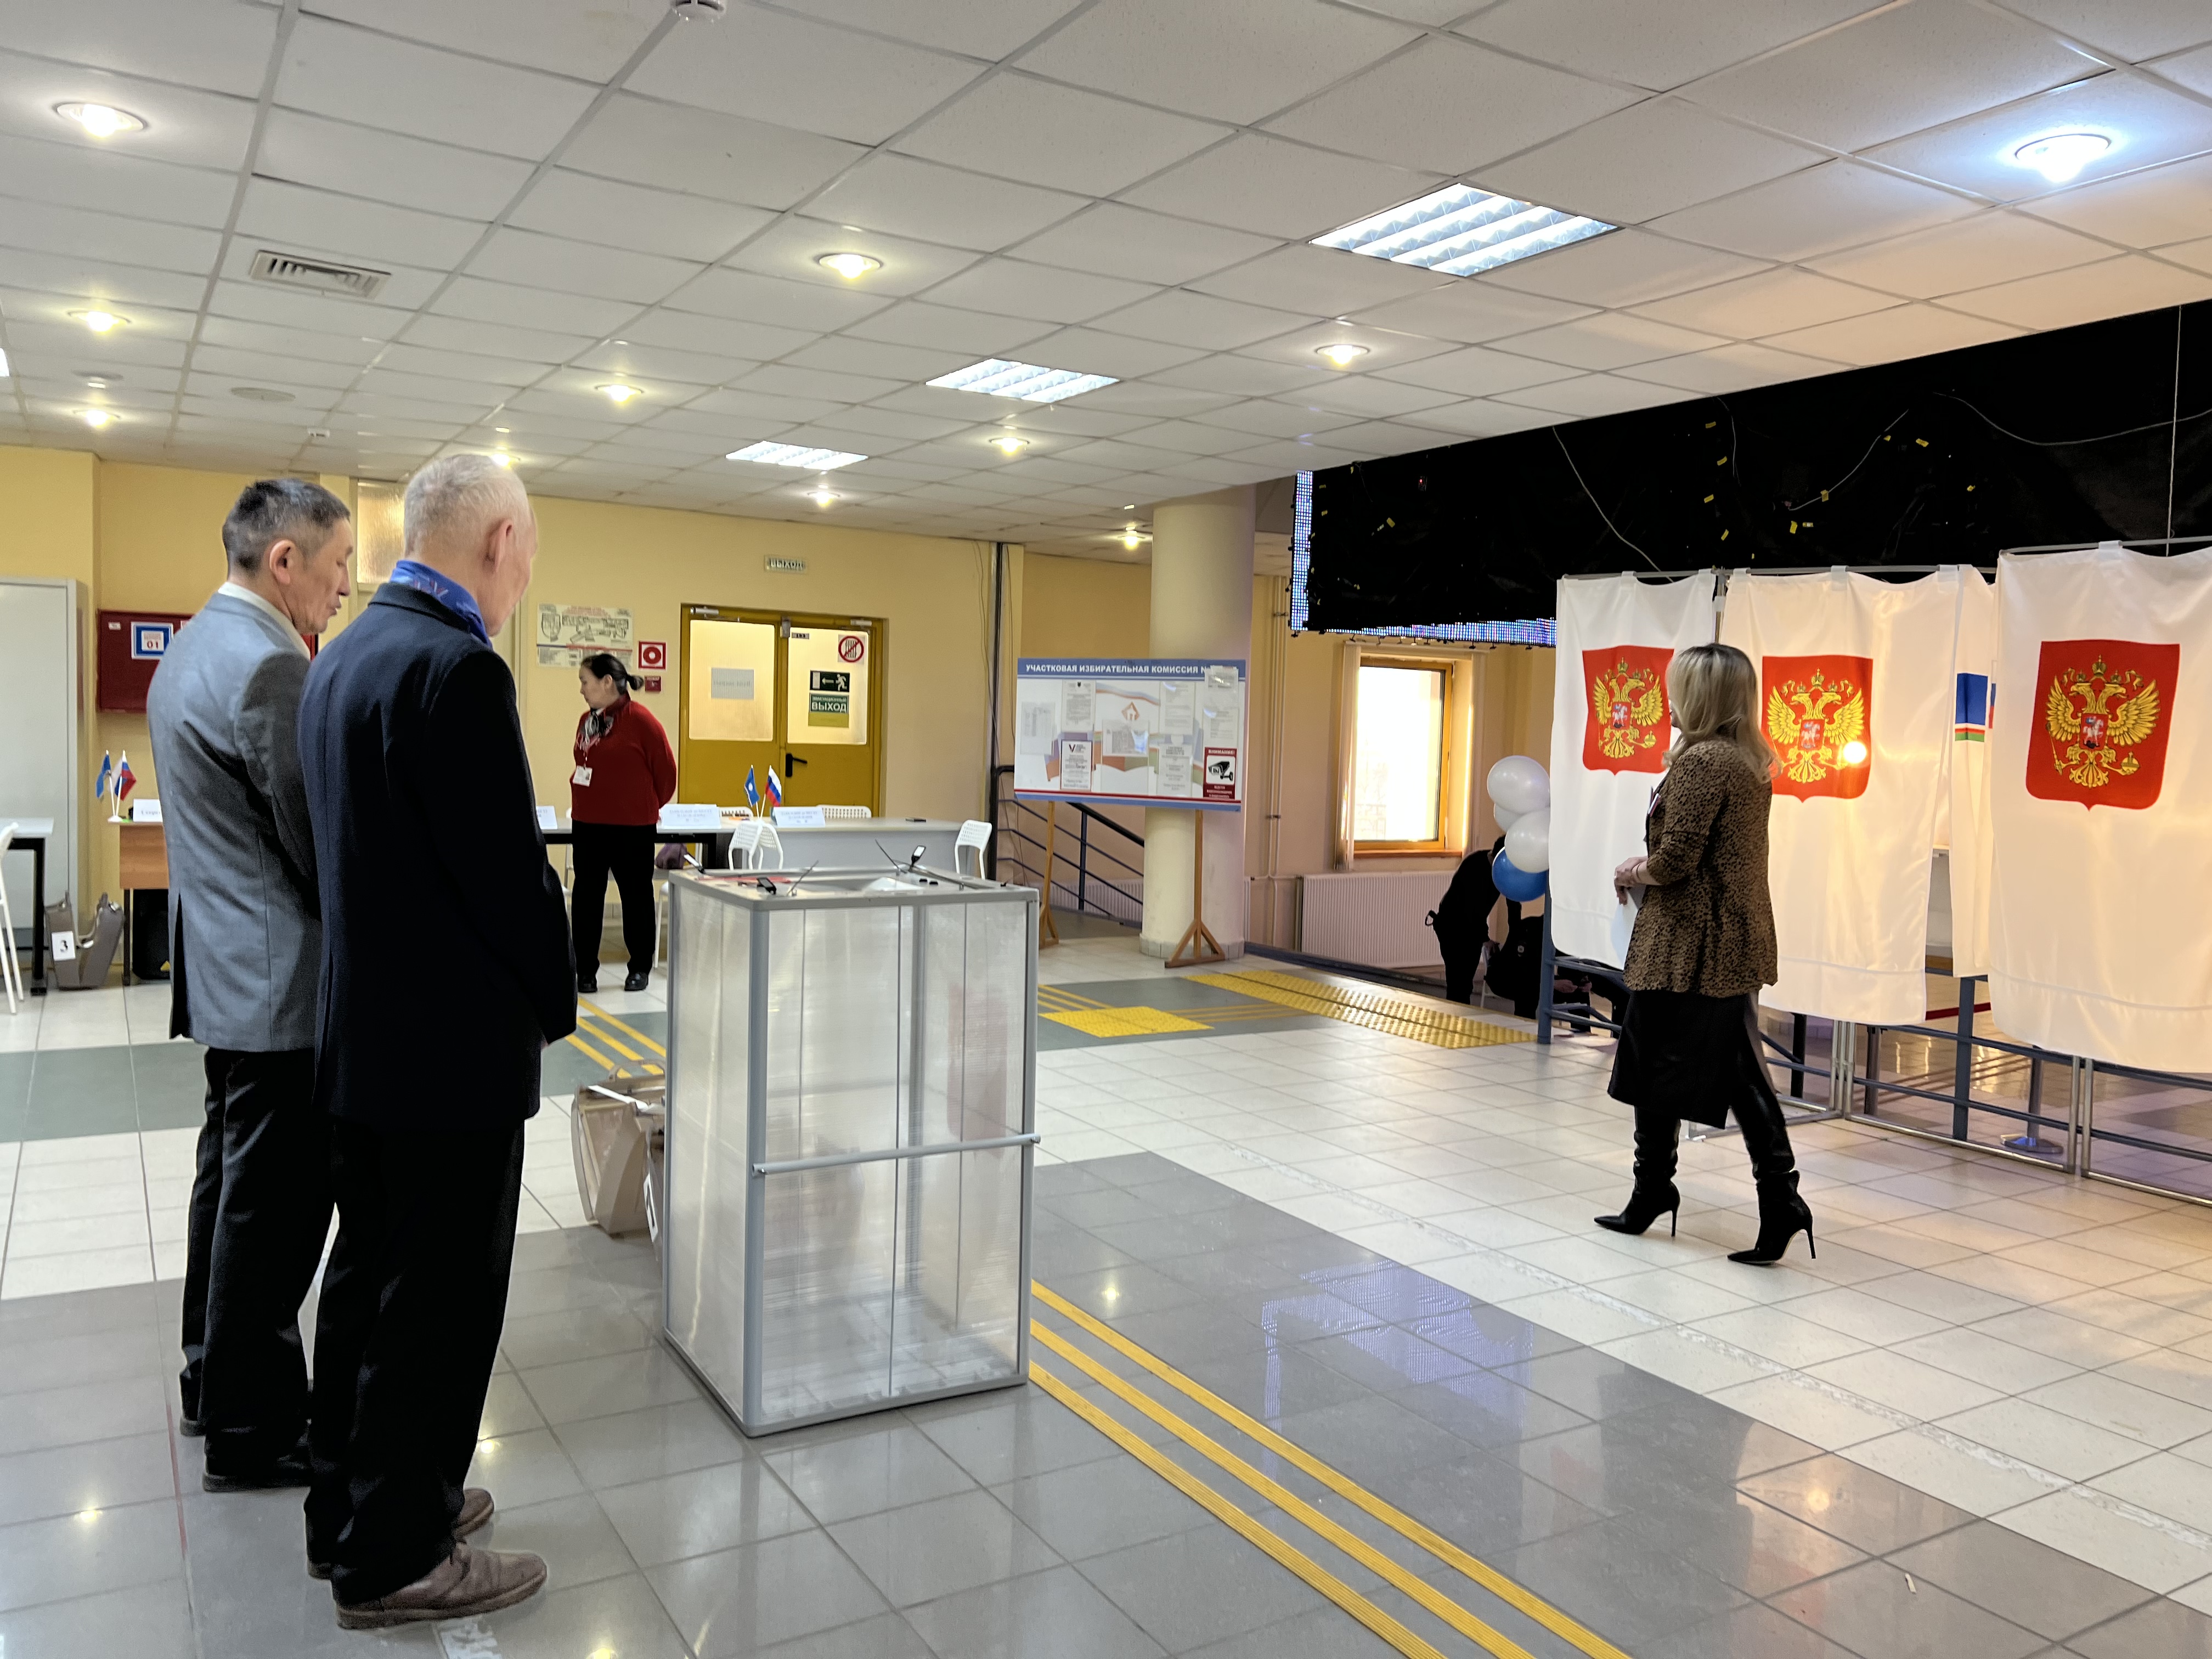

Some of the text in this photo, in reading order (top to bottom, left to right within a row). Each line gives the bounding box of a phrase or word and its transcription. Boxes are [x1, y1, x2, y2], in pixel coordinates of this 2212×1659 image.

[770, 558, 803, 571] ВЫХОД
[146, 641, 159, 649] 01
[1079, 665, 1149, 673] ИЗБИРАТЕЛЬНАЯ
[1152, 665, 1198, 674] КОМИССИЯ
[812, 702, 847, 713] ВЫХОД
[60, 940, 68, 952] 3
